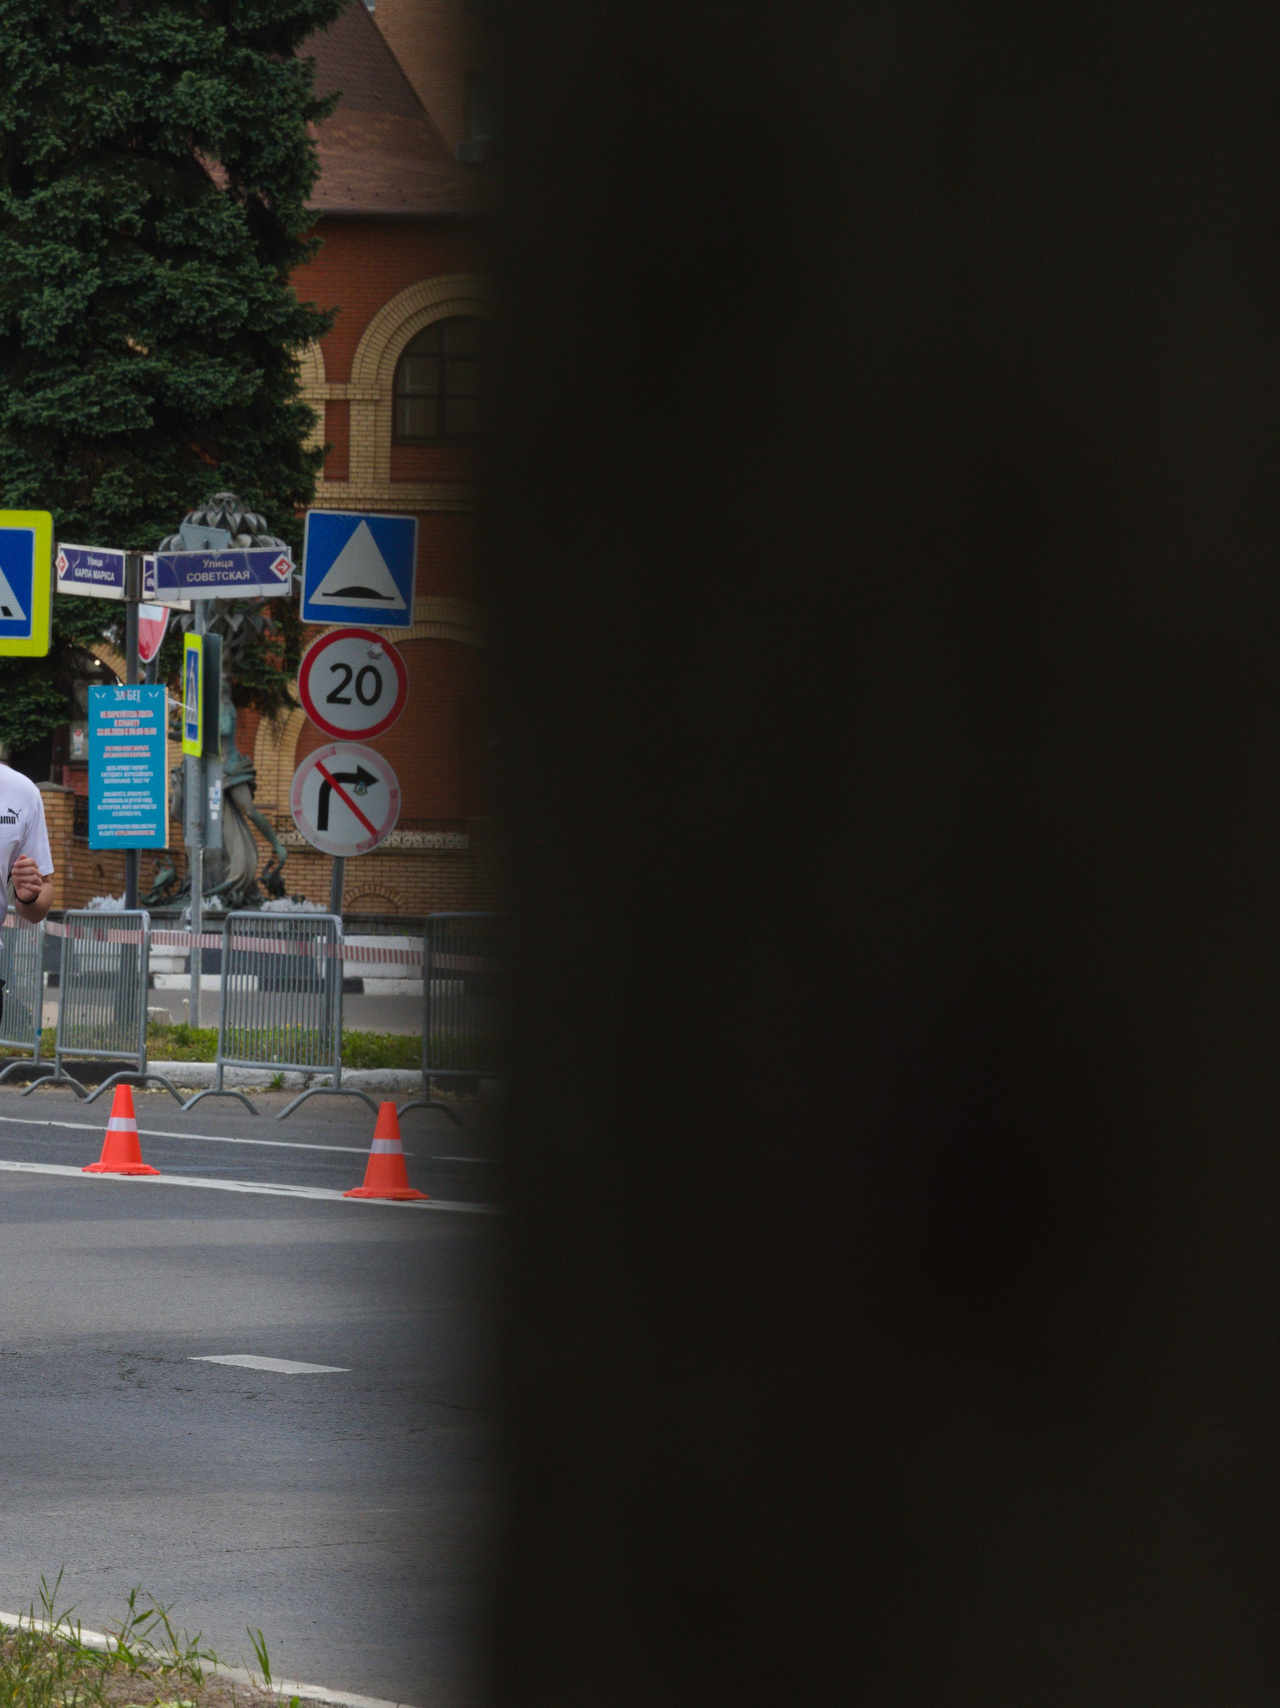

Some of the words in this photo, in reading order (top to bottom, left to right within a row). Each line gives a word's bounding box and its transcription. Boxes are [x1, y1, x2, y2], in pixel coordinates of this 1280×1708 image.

[87, 556, 103, 567] Улица
[202, 558, 234, 569] Улица
[74, 568, 92, 579] КАРЛА
[92, 569, 115, 582] МАРКСА
[186, 570, 250, 582] СОВЕТСКАЯ
[326, 662, 383, 706] 20
